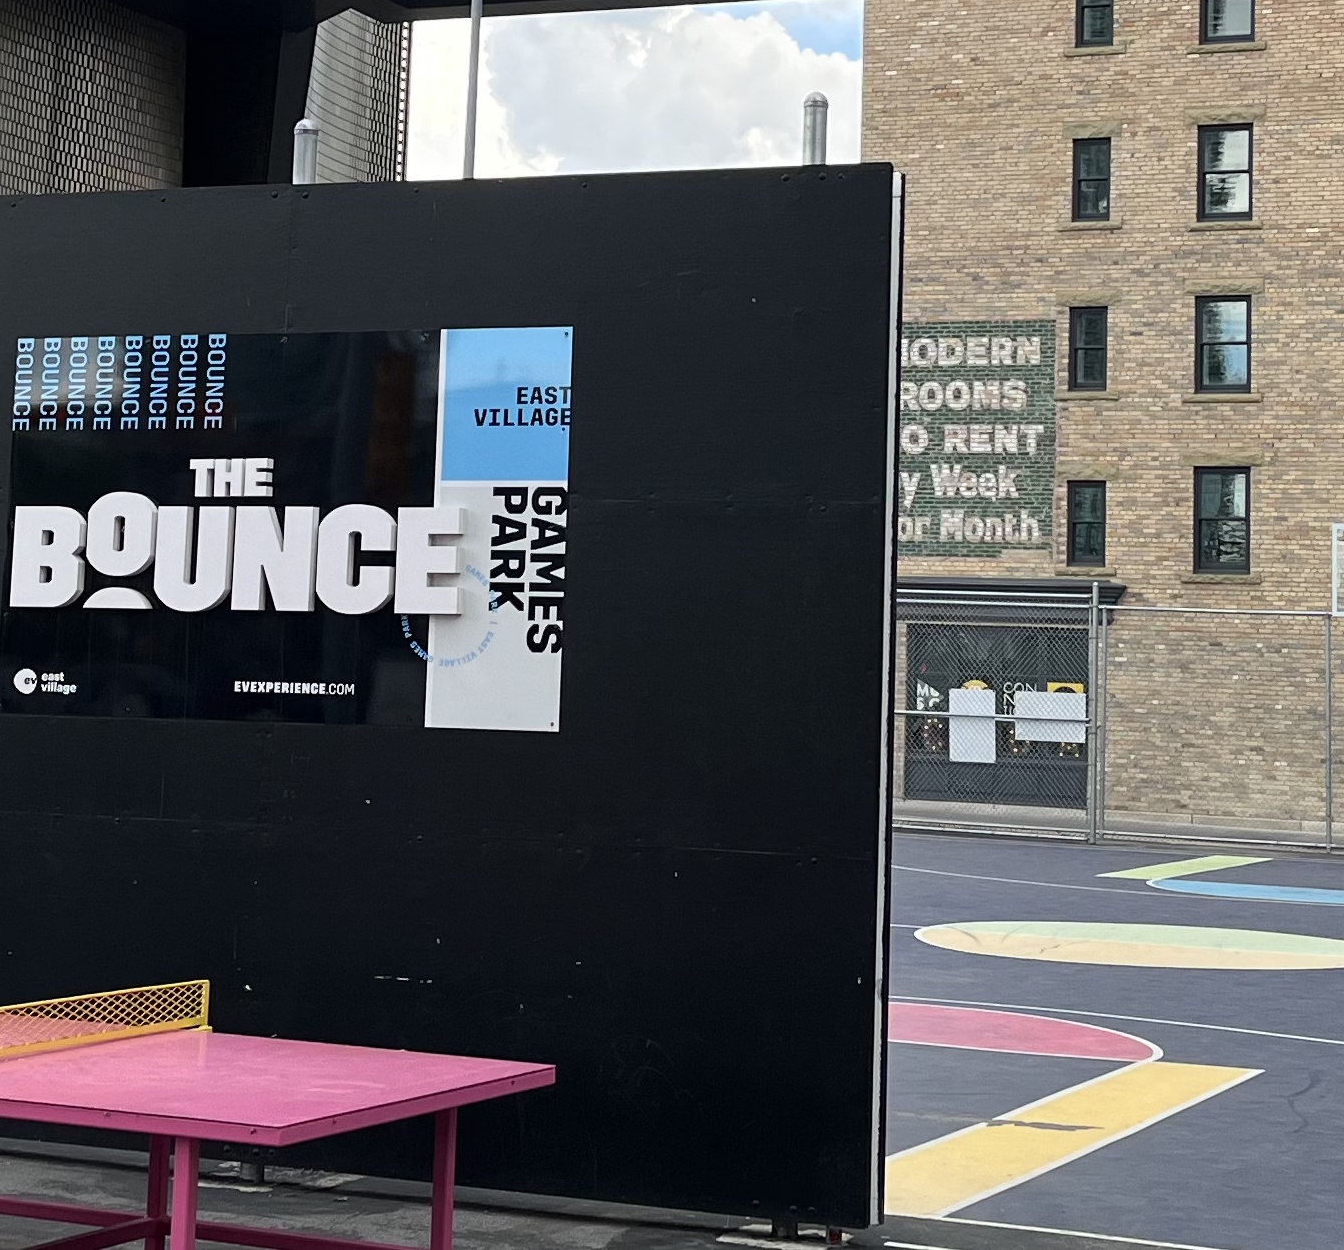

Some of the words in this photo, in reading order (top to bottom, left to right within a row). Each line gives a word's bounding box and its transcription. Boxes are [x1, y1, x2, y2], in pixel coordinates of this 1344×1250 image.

[12, 337, 35, 431] BOUNCE
[38, 337, 61, 431] BOUNCE
[65, 337, 88, 430] BOUNCE
[93, 336, 116, 430] BOUNCE
[120, 335, 143, 430] BOUNCE
[147, 335, 171, 430] BOUNCE
[175, 334, 199, 430] BOUNCE
[204, 333, 227, 430] BOUNCE
[474, 407, 572, 427] VILLAGE
[516, 386, 572, 405] EAST
[190, 458, 275, 498] THE
[930, 463, 1021, 499] Week
[944, 424, 1044, 455] RENT
[10, 491, 465, 615] BOUNCE
[488, 486, 529, 612] PARK
[526, 486, 568, 654] GAMES
[940, 509, 1041, 543] Month
[465, 564, 489, 587] GAMES
[41, 672, 65, 682] east
[41, 682, 77, 695] village
[234, 680, 355, 695] EVEXPERIENCE.COM
